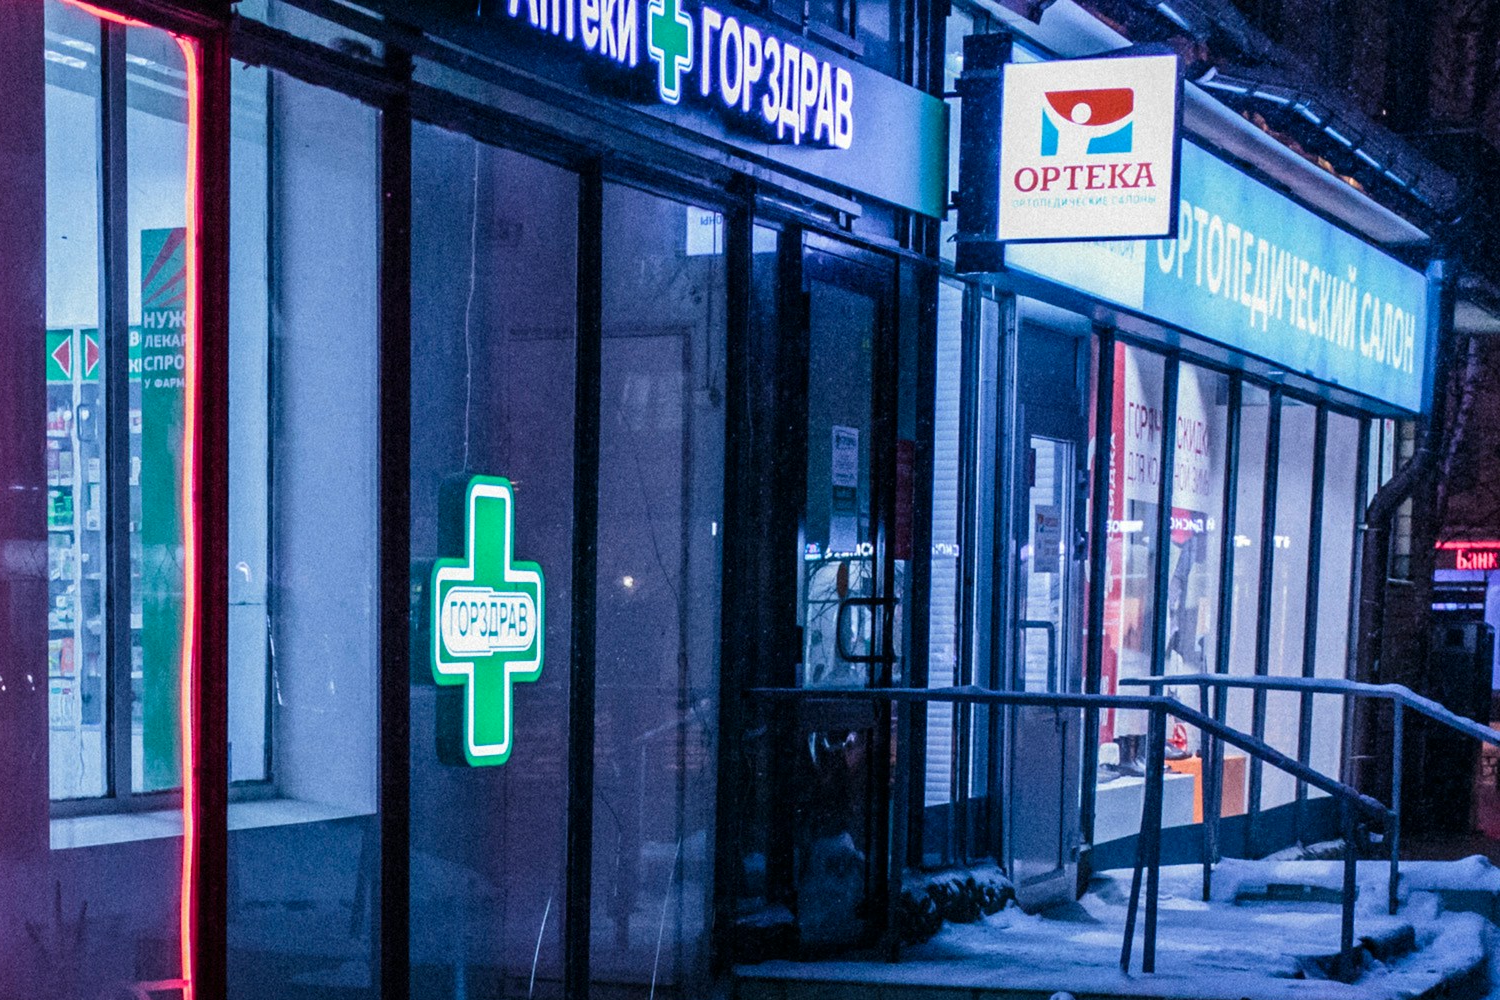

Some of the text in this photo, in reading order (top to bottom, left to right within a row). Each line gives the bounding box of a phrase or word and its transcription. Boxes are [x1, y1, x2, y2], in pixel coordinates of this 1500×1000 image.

[700, 9, 854, 151] ГОРЗДРАВ
[1013, 162, 1157, 193] ОРТЕКА
[1011, 194, 1156, 209] ОРТОПЕДИЧЕСКИЕ САЛОНЫ
[1360, 291, 1416, 374] САЛОН
[143, 354, 186, 371] СПРО
[1456, 548, 1498, 569] Банк
[449, 600, 528, 643] ГОРЗДРАВ
